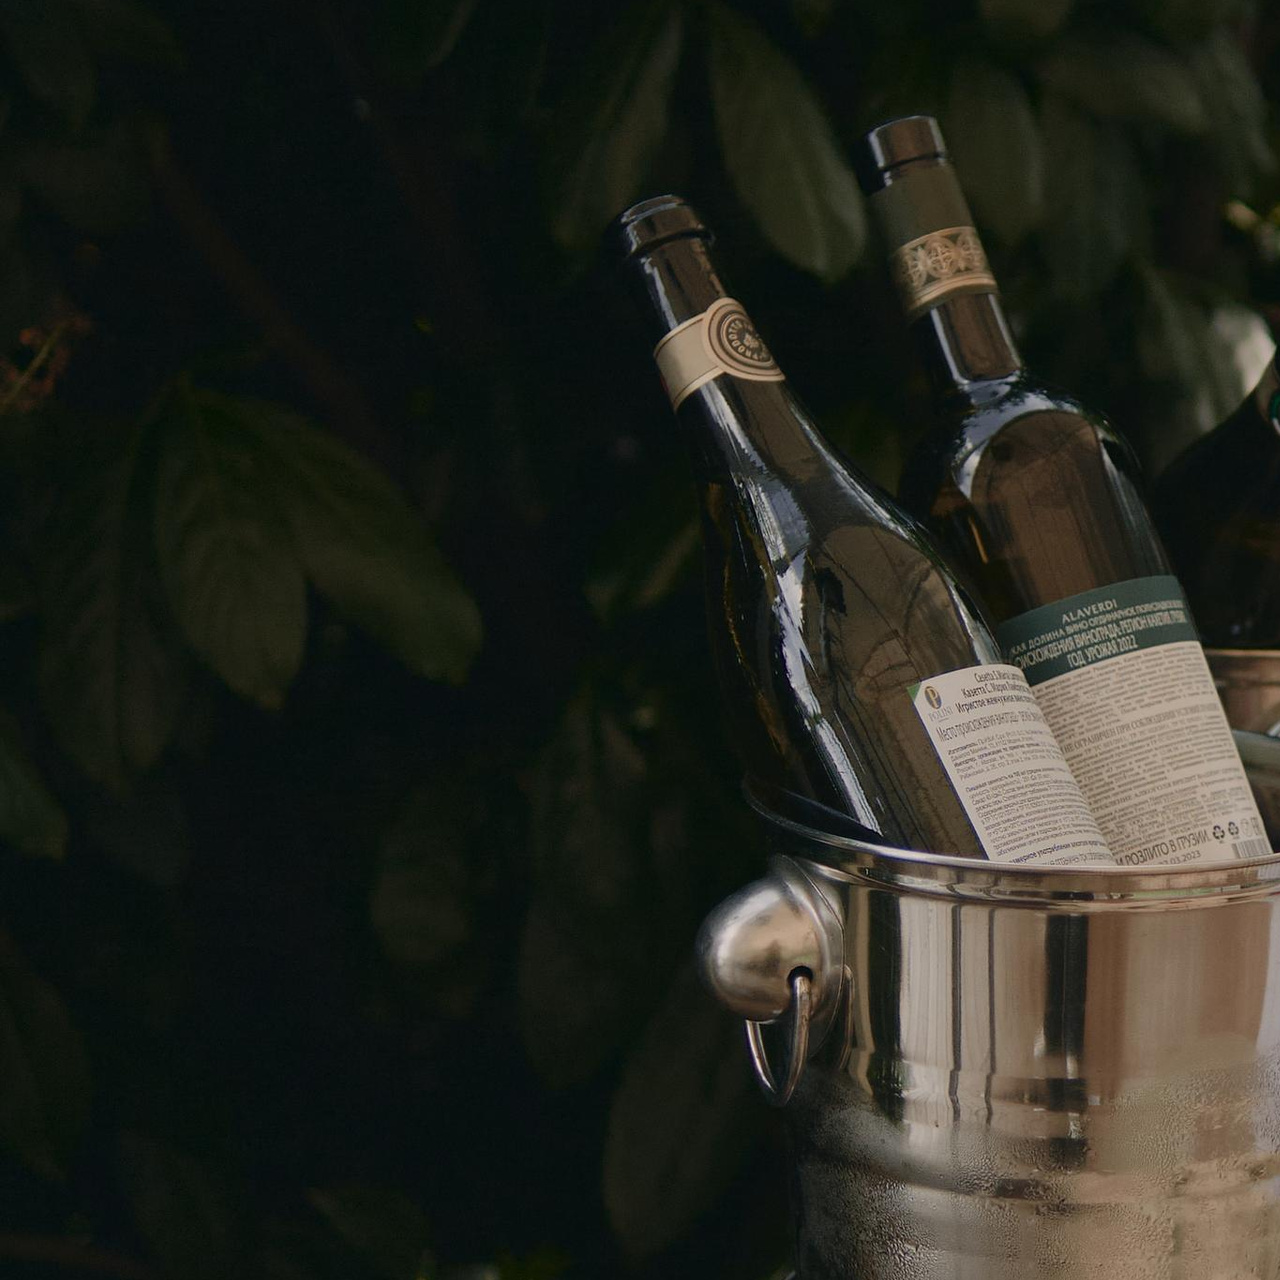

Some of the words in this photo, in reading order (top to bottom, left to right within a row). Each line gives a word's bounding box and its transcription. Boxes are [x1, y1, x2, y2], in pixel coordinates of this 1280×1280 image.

[1062, 599, 1118, 624] ALAVERDI
[1027, 628, 1065, 650] ДОЛИНА
[1067, 649, 1086, 669] ГОД
[1087, 639, 1117, 662] УРОЖАЯ
[1117, 633, 1139, 653] 2022
[961, 685, 986, 699] Казетта
[955, 698, 986, 714] Игристое
[936, 723, 958, 742] Место
[1124, 840, 1169, 866] РОЗЛИТО
[1169, 839, 1178, 853] В
